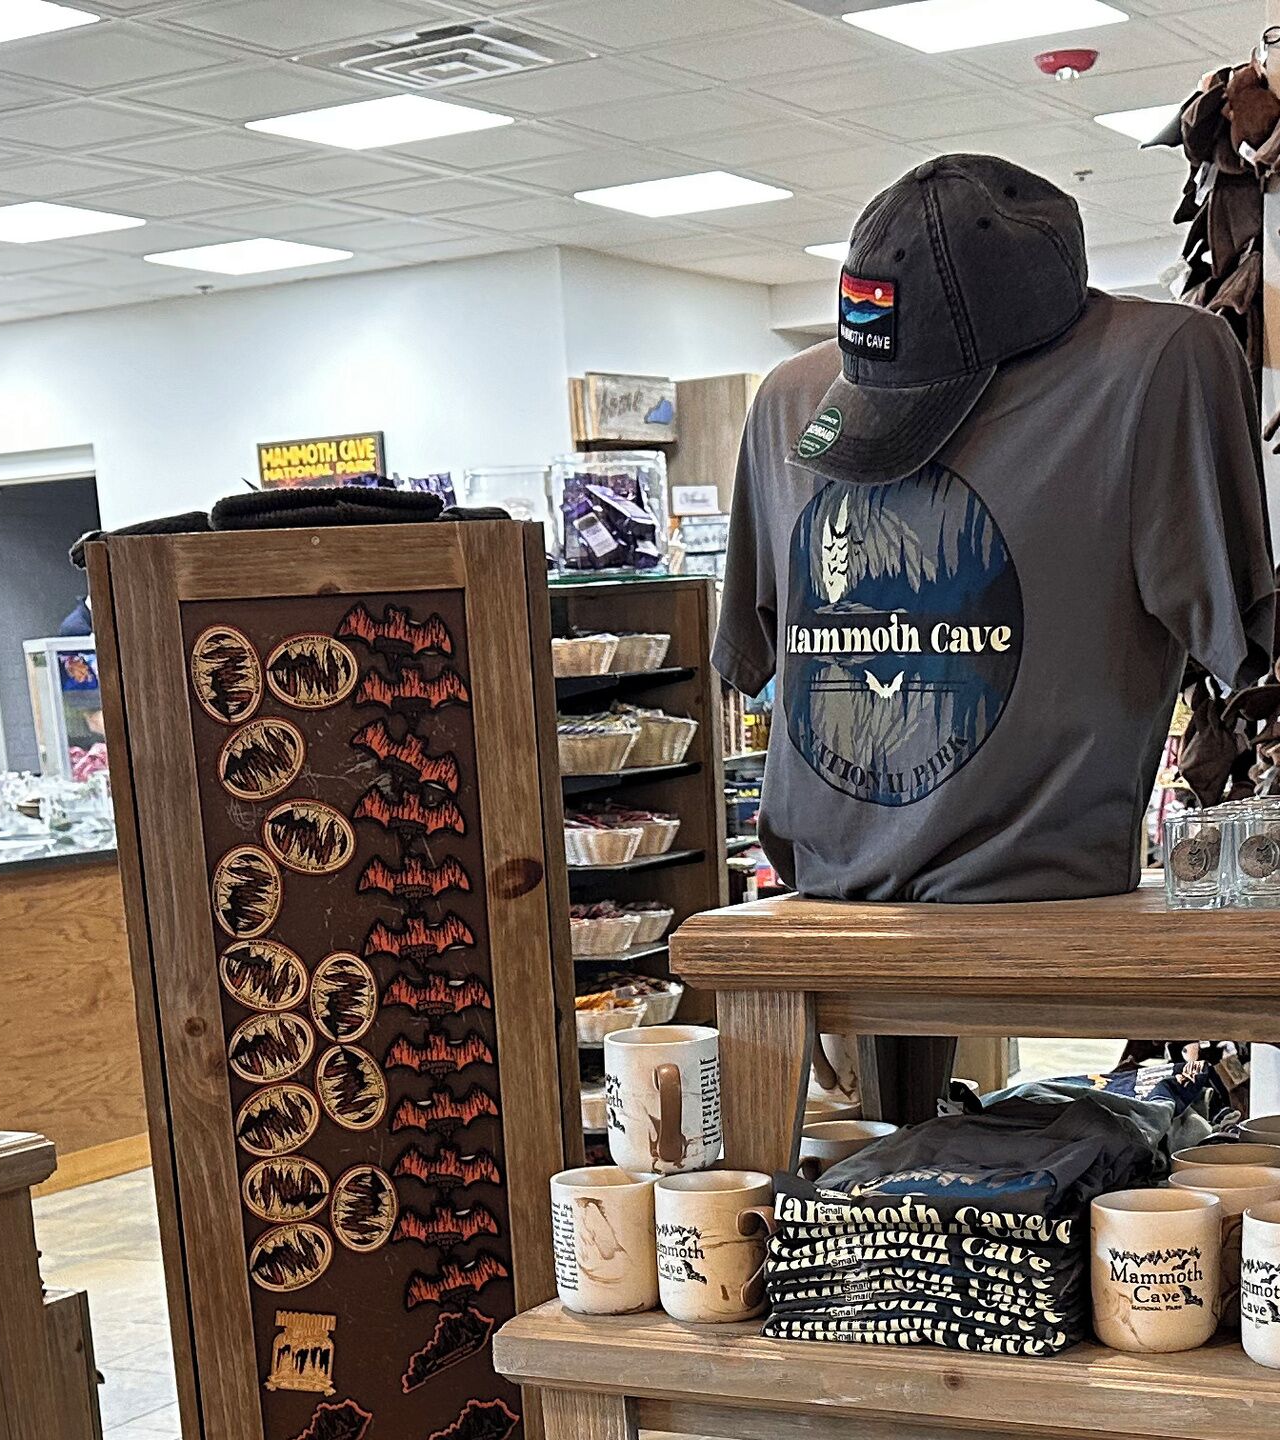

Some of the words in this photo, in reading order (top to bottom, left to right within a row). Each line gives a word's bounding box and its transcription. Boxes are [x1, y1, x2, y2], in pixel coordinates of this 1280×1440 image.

[866, 333, 891, 350] CAVE
[261, 442, 338, 469] MAMMOTH
[339, 437, 377, 460] CAVE
[263, 463, 334, 481] NATIONAL
[336, 460, 376, 475] PARK
[931, 622, 1012, 653] Cave
[820, 1206, 843, 1215] Small
[1110, 1261, 1203, 1285] Mammoth
[1133, 1286, 1181, 1306] Cave
[831, 1309, 857, 1318] Small
